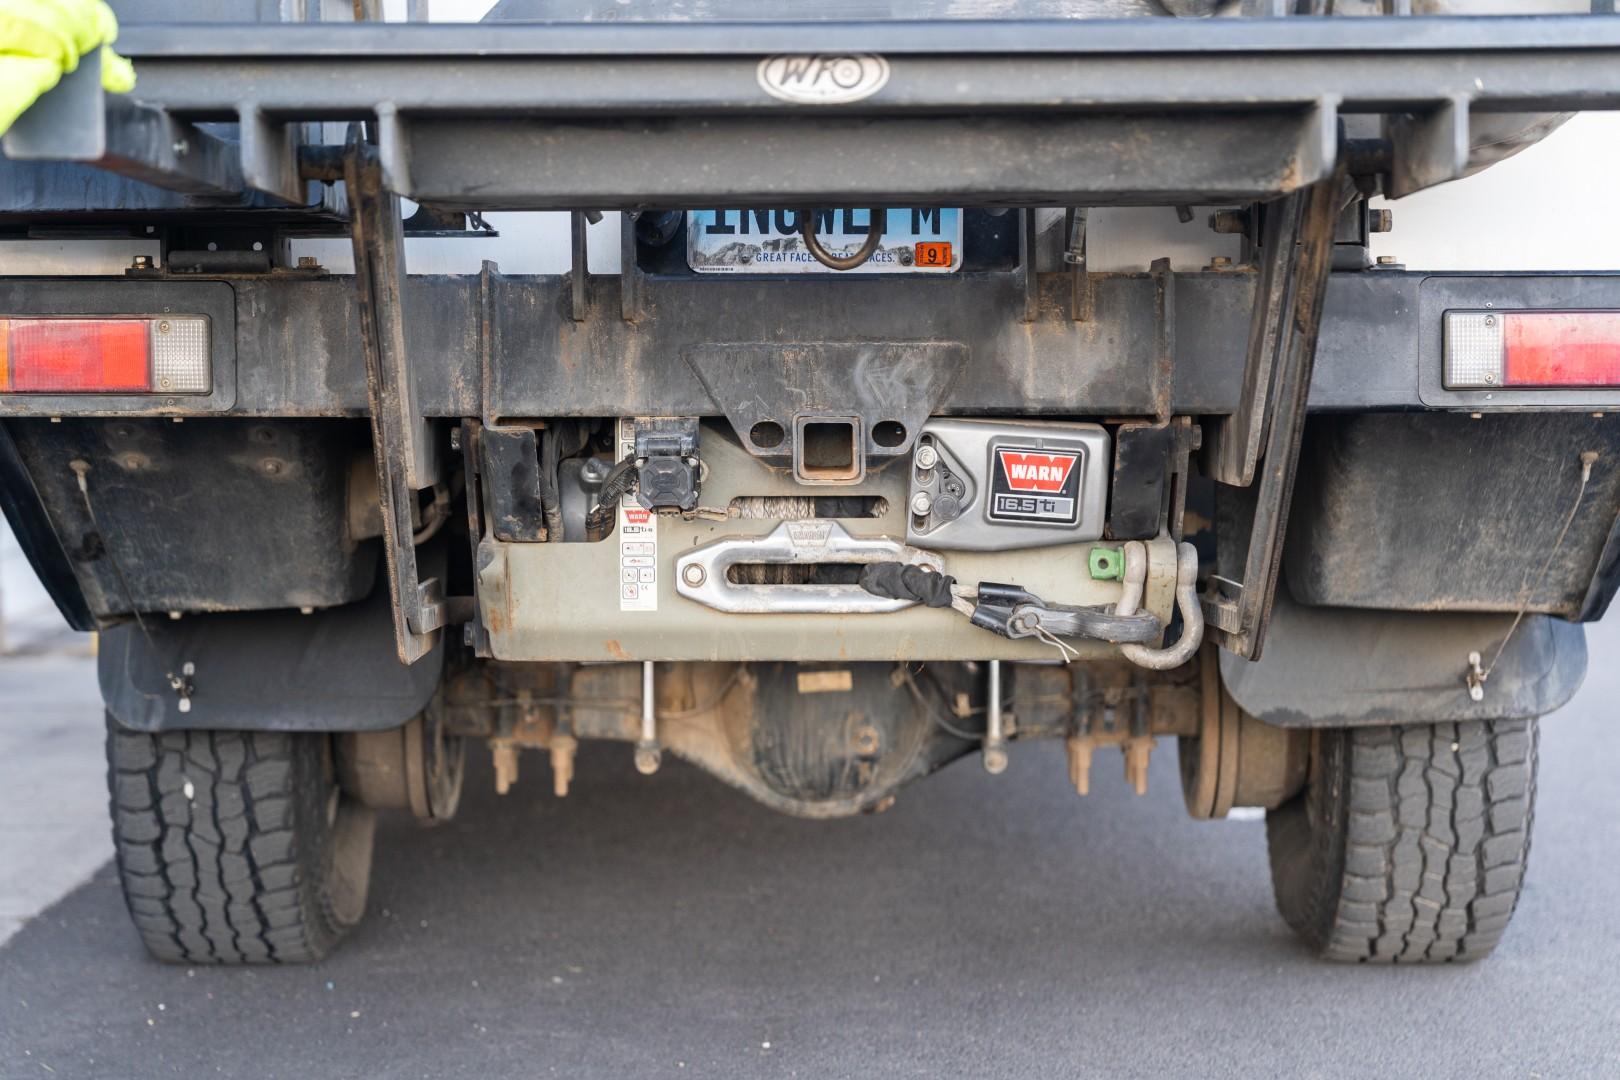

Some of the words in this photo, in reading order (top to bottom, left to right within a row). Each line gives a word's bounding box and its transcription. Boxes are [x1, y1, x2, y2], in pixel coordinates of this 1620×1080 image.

[756, 252, 786, 262] GREAT
[928, 248, 937, 263] 9
[1011, 464, 1063, 482] WARN
[1000, 498, 1035, 512] 16.5
[1040, 499, 1055, 512] ti
